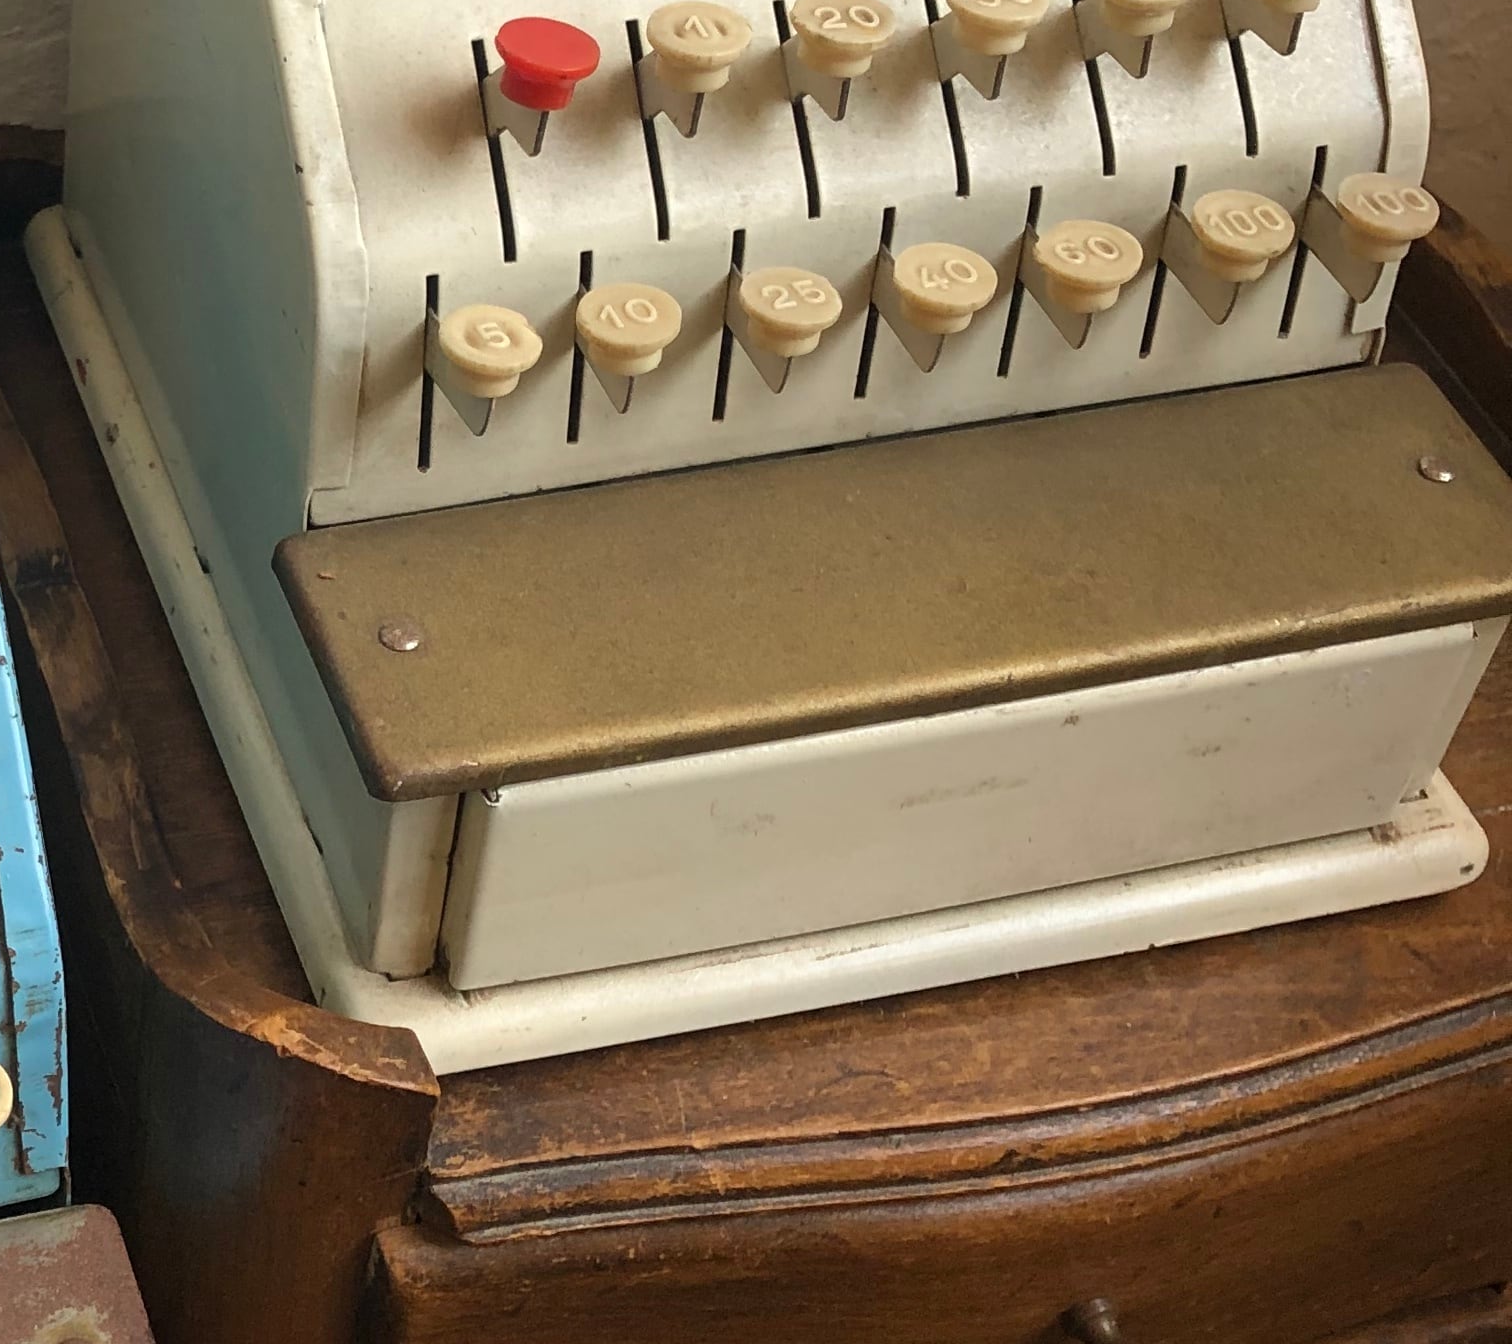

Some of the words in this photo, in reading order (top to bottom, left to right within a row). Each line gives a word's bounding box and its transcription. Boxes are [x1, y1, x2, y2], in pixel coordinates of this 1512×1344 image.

[684, 15, 709, 37] 1
[814, 5, 880, 28] 20
[475, 322, 511, 349] 5
[599, 298, 658, 329] 10
[761, 279, 827, 310] 25
[919, 259, 978, 289] 40
[1054, 236, 1120, 264] 60
[1209, 205, 1285, 237] 100
[1356, 187, 1430, 216] 100
